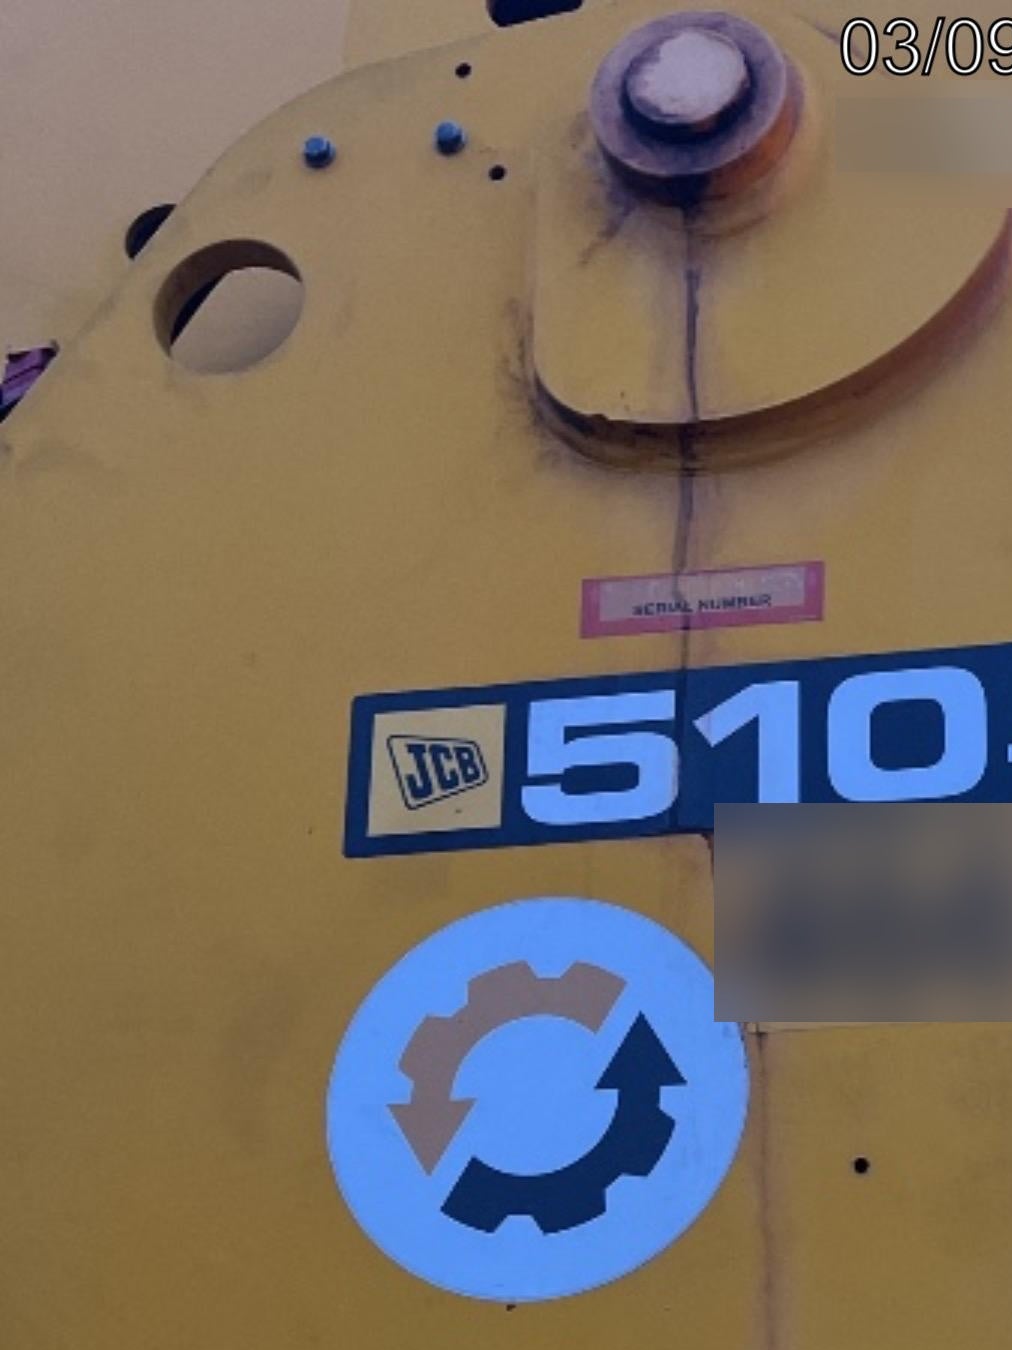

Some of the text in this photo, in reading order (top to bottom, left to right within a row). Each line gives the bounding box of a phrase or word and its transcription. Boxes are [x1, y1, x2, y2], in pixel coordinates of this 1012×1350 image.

[632, 593, 772, 616] SERIAL NUMBER
[405, 743, 481, 799] JCB
